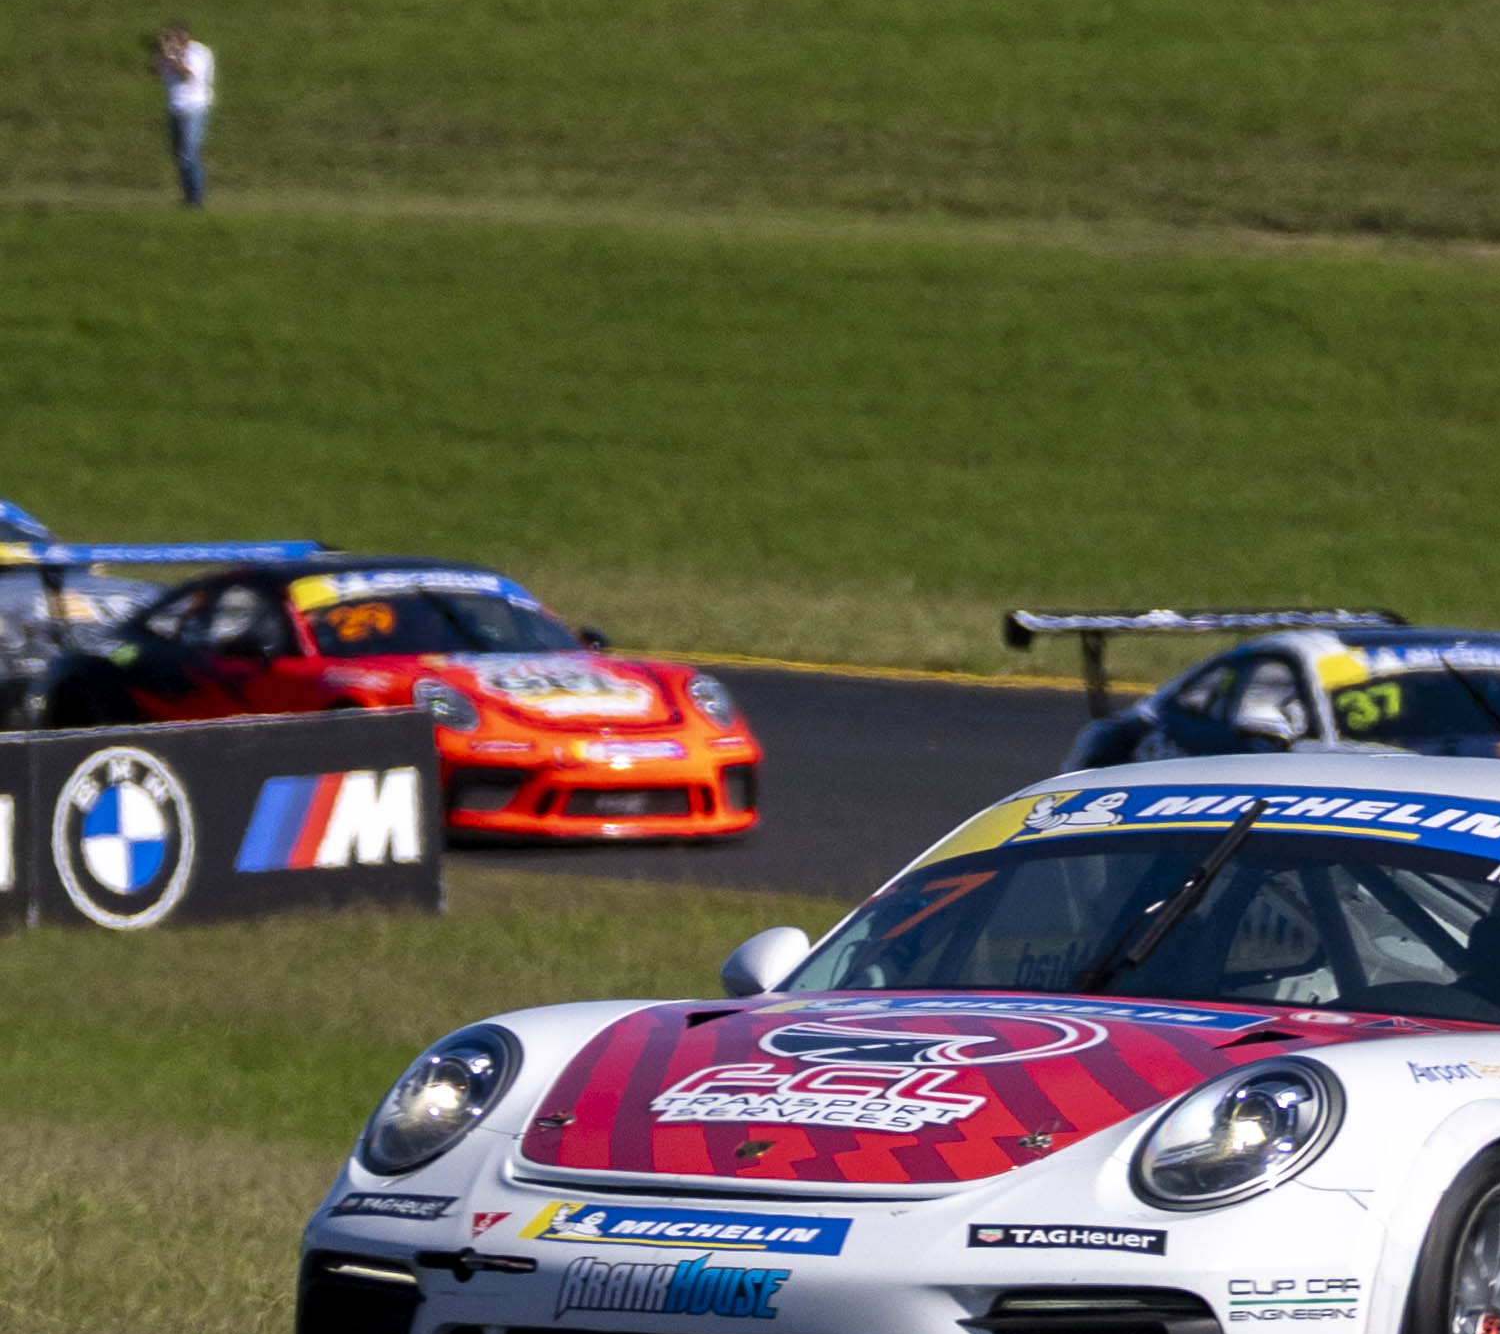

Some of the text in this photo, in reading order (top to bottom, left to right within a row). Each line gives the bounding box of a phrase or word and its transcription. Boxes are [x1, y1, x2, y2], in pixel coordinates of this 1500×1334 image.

[1335, 681, 1402, 732] 37
[311, 766, 421, 868] M
[903, 1000, 1221, 1022] MICHELIN
[663, 1063, 988, 1108] FCL
[662, 1095, 962, 1120] TRANSPORT
[673, 1107, 915, 1129] SERVICES
[609, 1218, 823, 1244] MICHELIN
[1009, 1228, 1157, 1249] TAGHeuer
[1228, 1277, 1296, 1295] CUP
